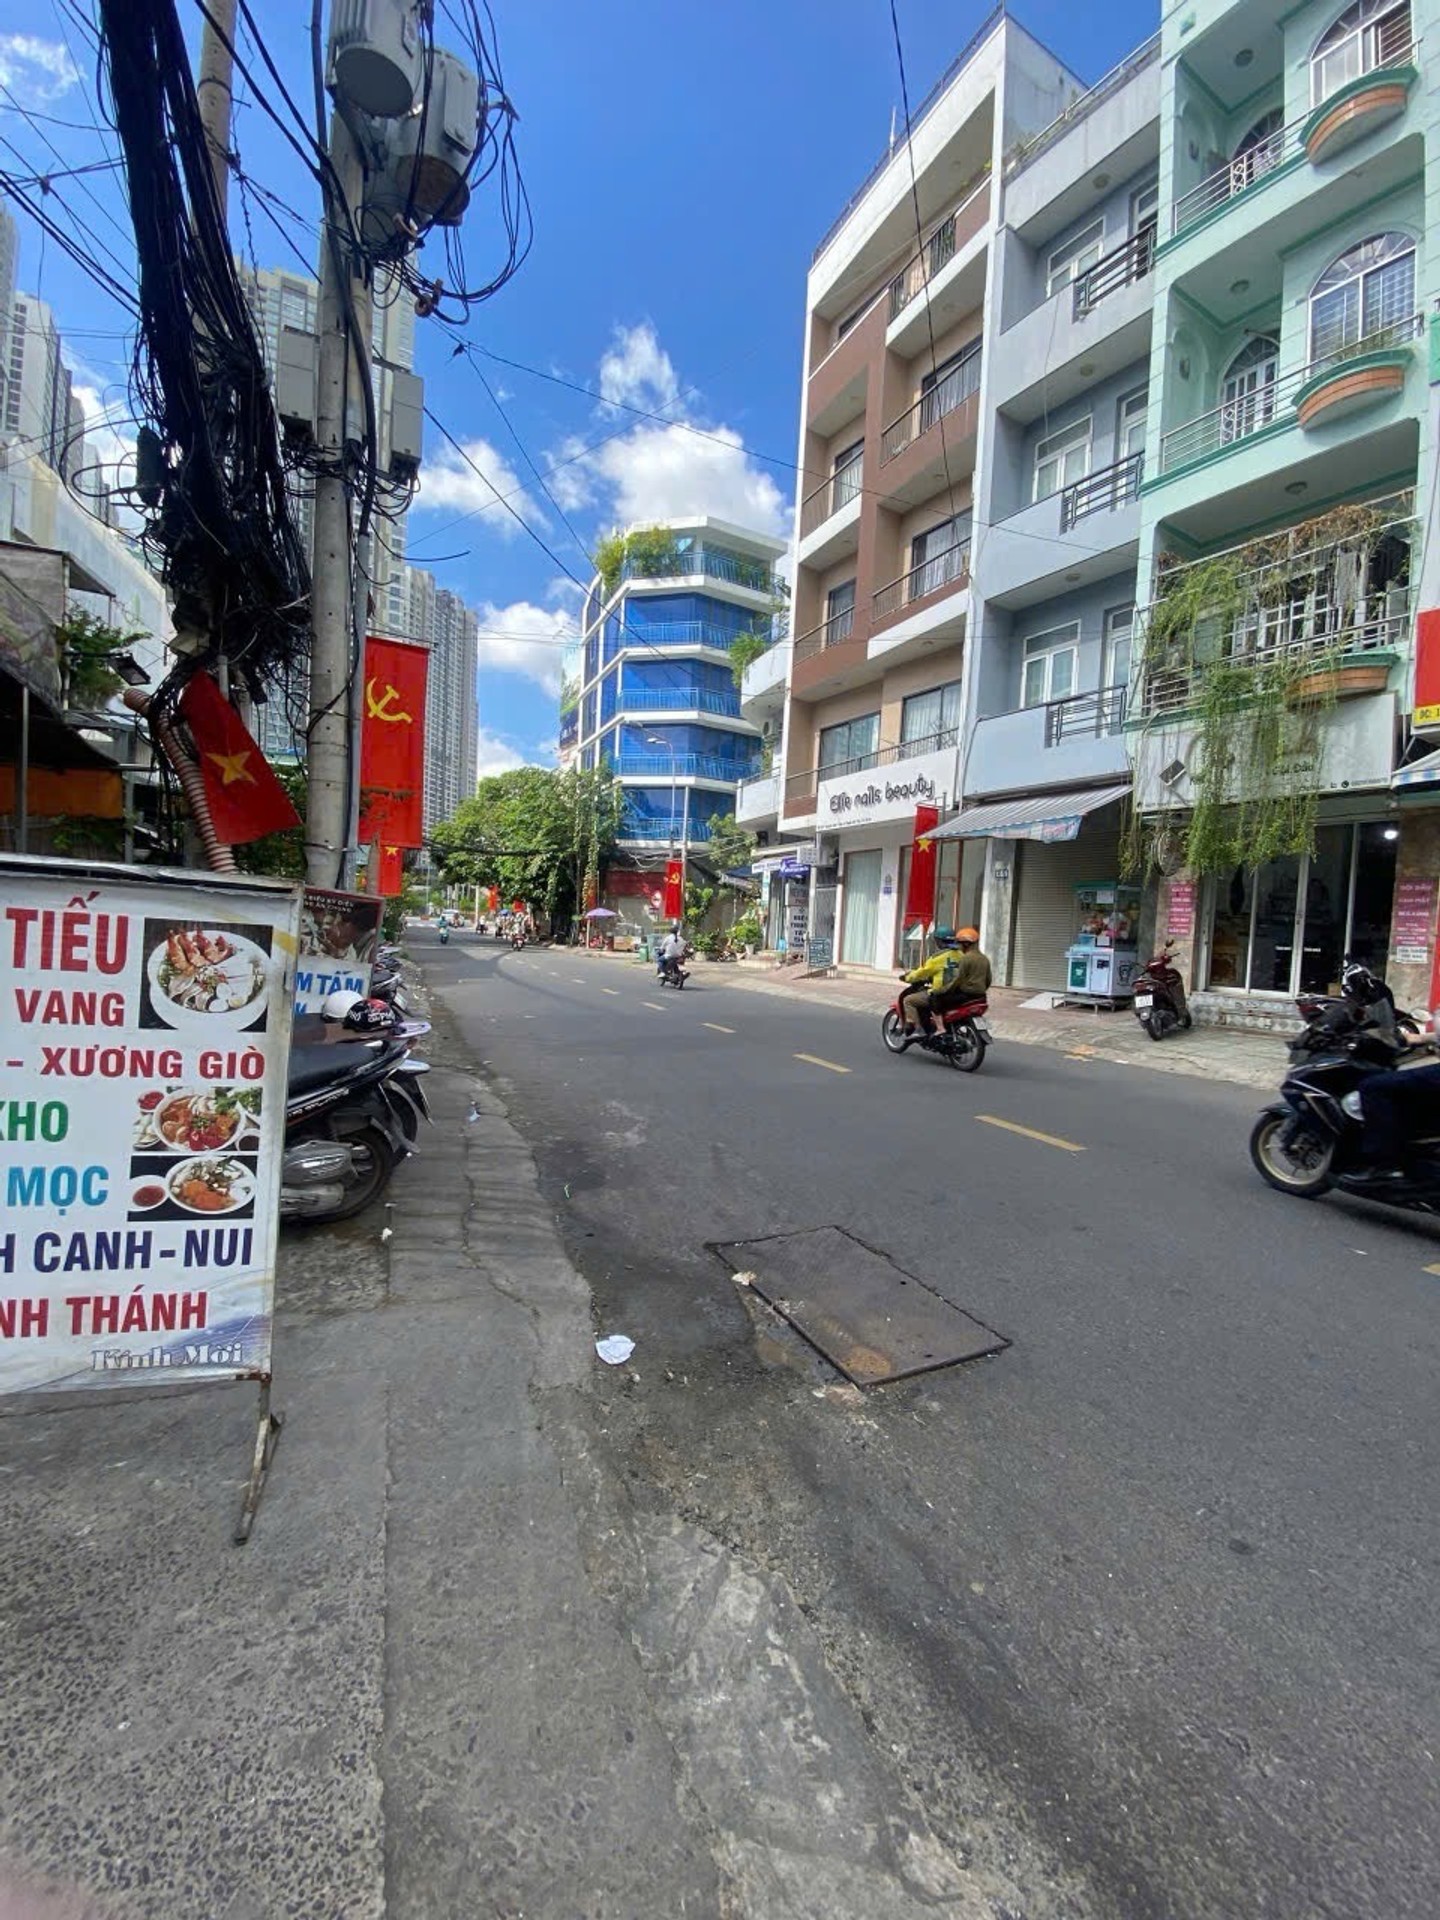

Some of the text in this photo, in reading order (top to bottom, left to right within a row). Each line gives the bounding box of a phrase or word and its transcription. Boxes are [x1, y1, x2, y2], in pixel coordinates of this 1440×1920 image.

[885, 773, 935, 802] beauty
[6, 890, 129, 975] TIẾU
[317, 970, 364, 996] TẤM
[14, 988, 125, 1027] VANG
[40, 1044, 183, 1079] XƯƠNG
[199, 1045, 266, 1080] GIÒ
[0, 1100, 69, 1143] HO
[7, 1165, 109, 1217] MỌC
[66, 1284, 207, 1336] THÁNH
[92, 1342, 243, 1371] Kính Mời
